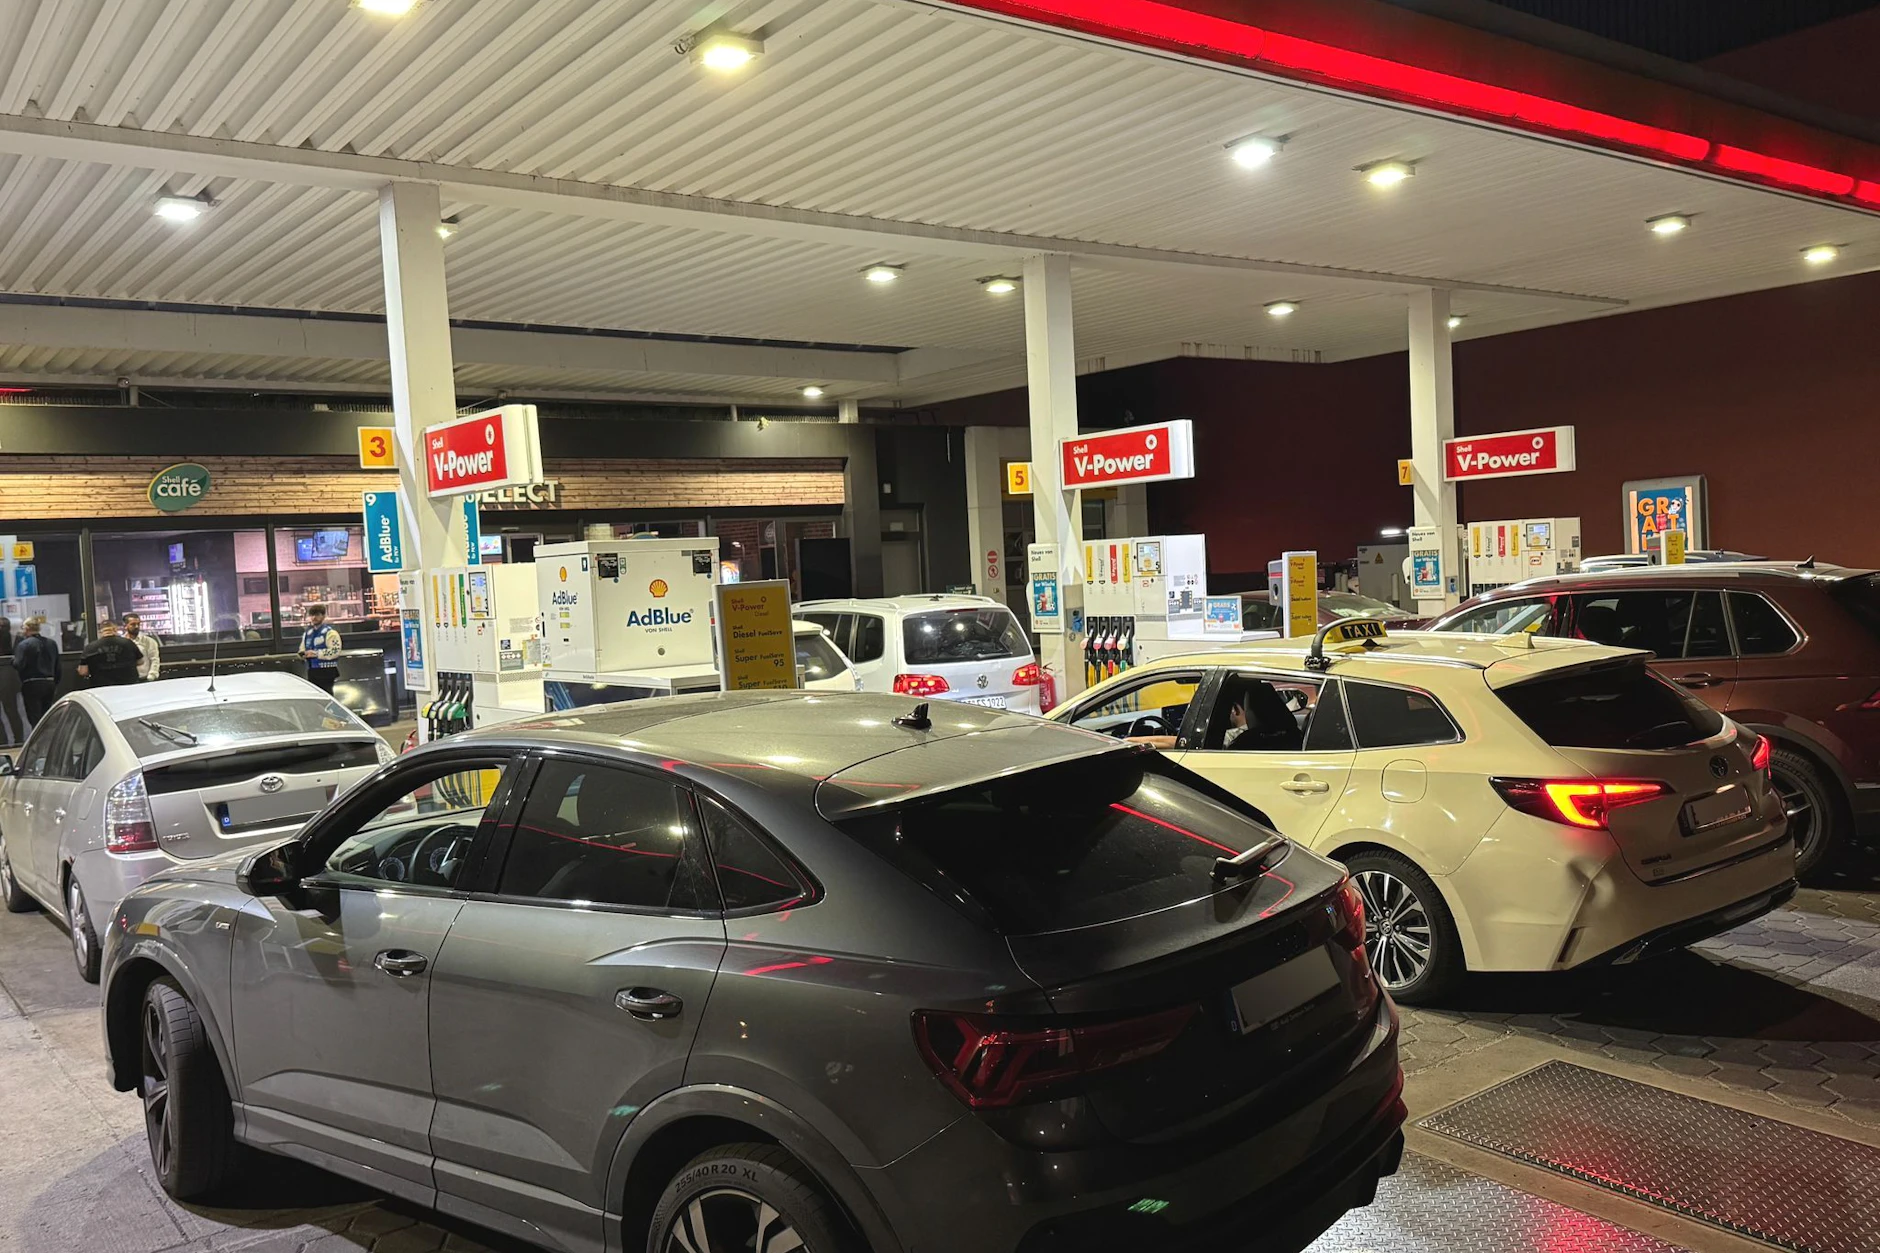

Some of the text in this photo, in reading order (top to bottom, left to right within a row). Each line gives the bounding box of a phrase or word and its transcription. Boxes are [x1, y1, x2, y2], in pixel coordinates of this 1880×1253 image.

[369, 436, 386, 458] 3
[431, 436, 444, 450] Shell
[1073, 444, 1088, 455] Shell
[1456, 445, 1472, 453] Shell
[433, 449, 494, 481] V-Power
[1073, 452, 1154, 478] V-Power
[1456, 451, 1540, 472] V-Power
[1015, 470, 1024, 486] 5
[1401, 466, 1408, 480] 7
[157, 478, 202, 497] café
[365, 494, 377, 506] 9
[1637, 496, 1669, 516] GR
[1033, 573, 1056, 581] GRATIS
[732, 604, 765, 612] V-Power
[733, 630, 756, 639] Diesel
[1344, 623, 1378, 637] TAXI
[735, 654, 758, 663] Super
[773, 659, 785, 667] 95
[738, 680, 760, 689] Super
[742, 1168, 759, 1183] XL
